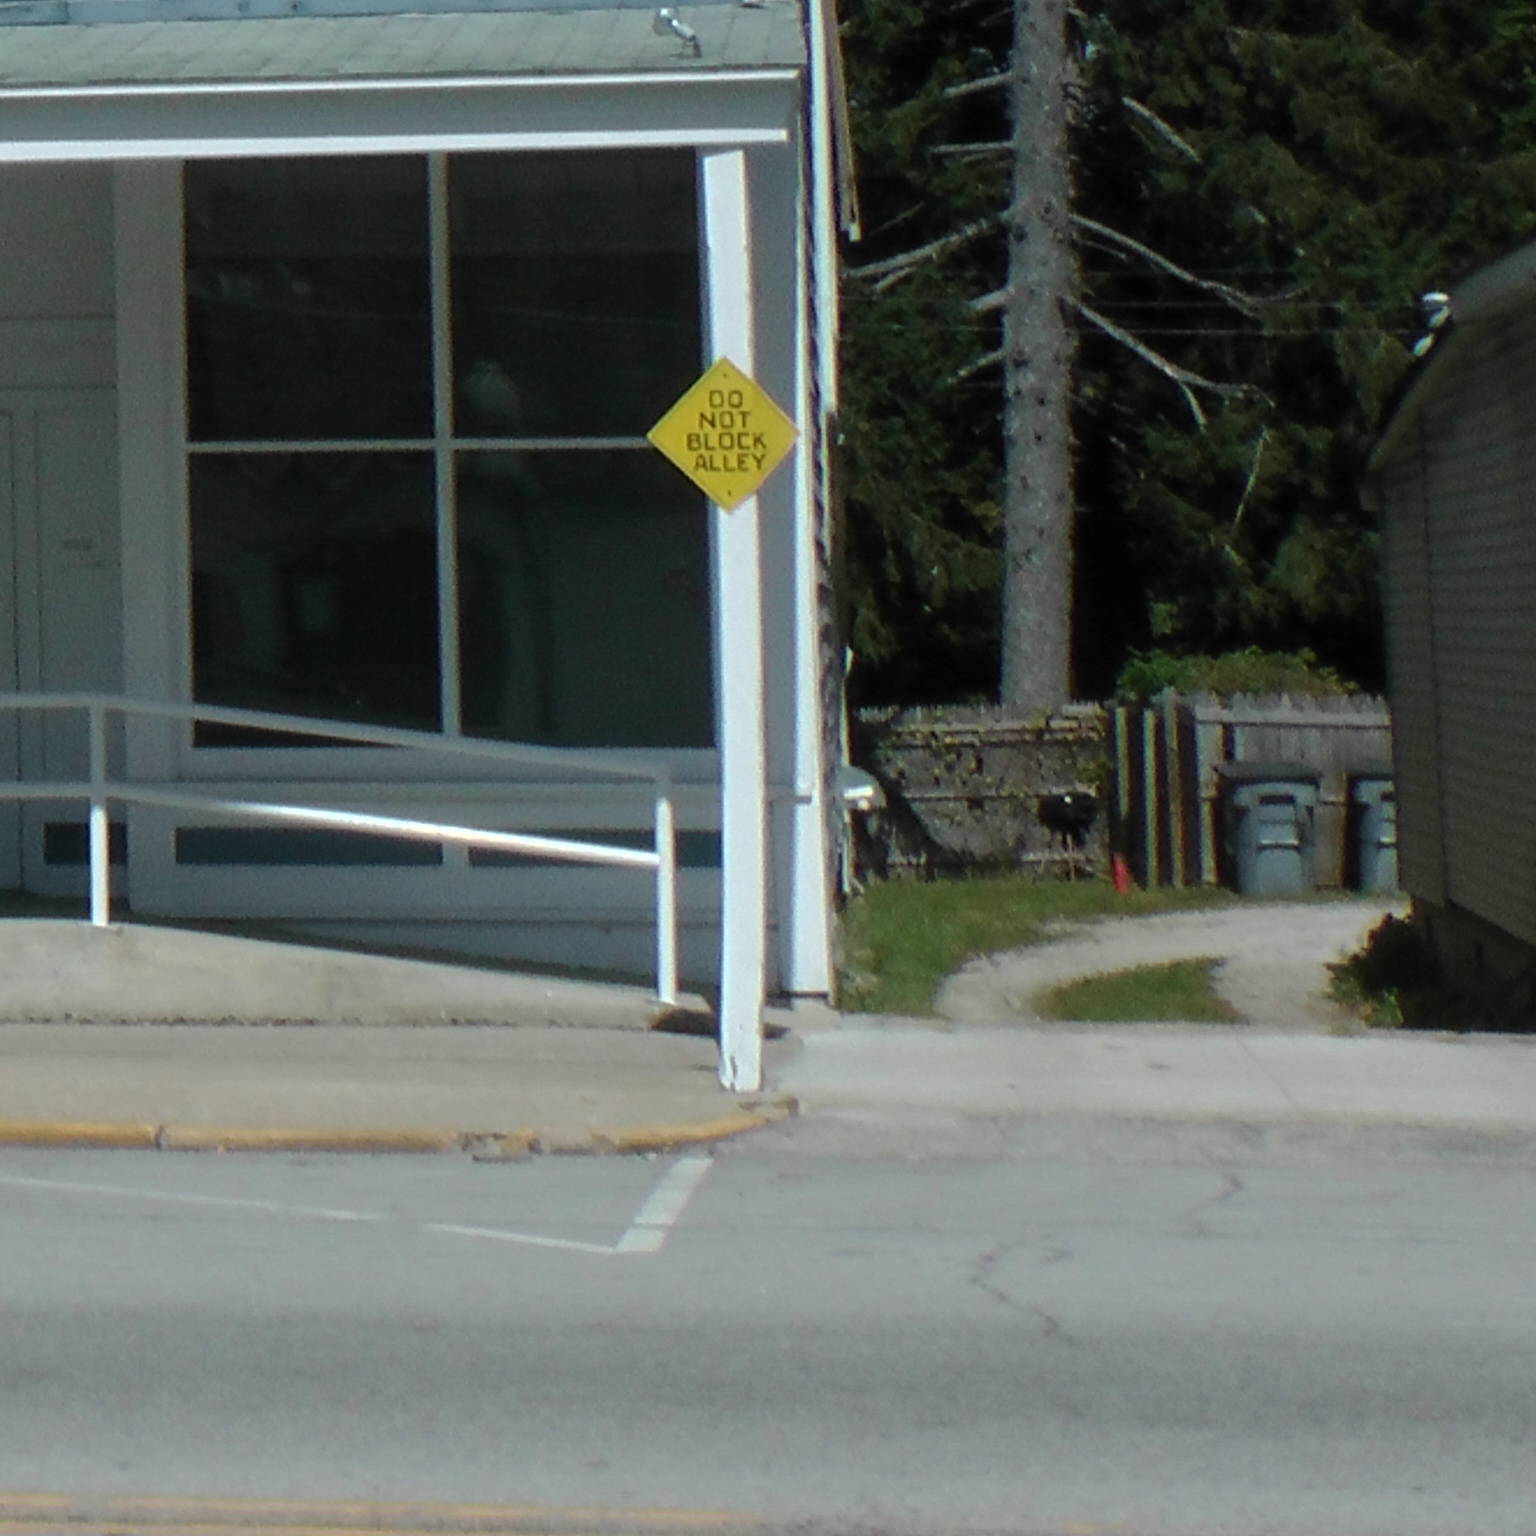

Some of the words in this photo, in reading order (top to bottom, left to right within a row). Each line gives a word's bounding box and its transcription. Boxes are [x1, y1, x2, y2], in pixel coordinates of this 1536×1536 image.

[708, 390, 744, 409] DO
[698, 411, 751, 429] NOT
[686, 432, 767, 452] BLOCK
[694, 452, 767, 473] ALLEY
